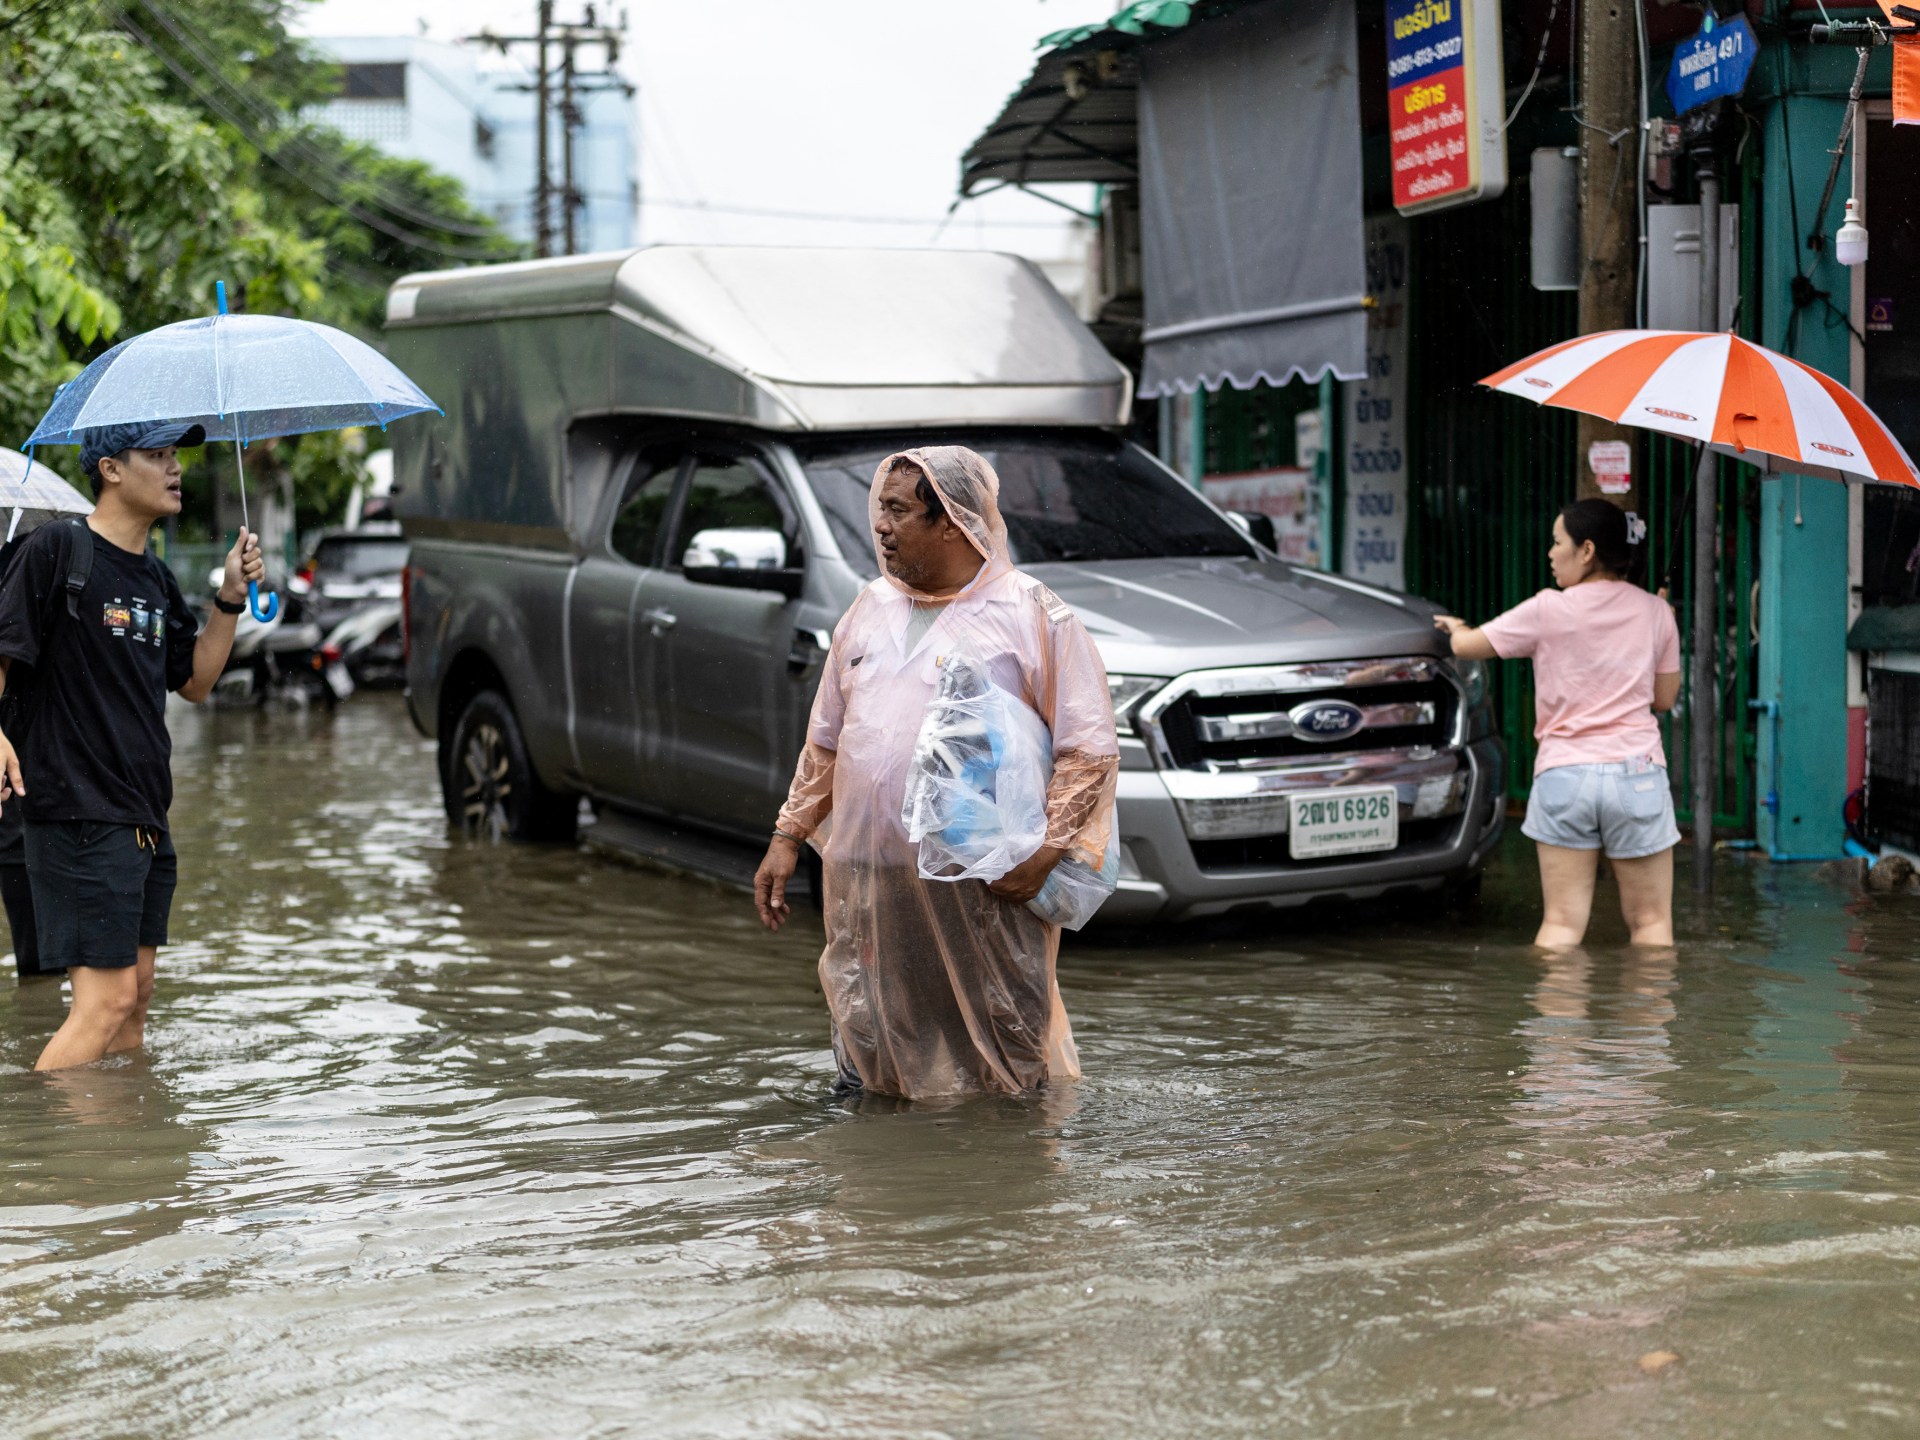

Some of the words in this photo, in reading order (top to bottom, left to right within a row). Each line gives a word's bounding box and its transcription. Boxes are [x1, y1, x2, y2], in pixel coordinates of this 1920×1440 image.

[1394, 0, 1450, 39] แอร์บ้าน
[1719, 31, 1742, 60] 49/1
[1714, 65, 1719, 84] 1
[1404, 84, 1447, 114] บริการ
[1312, 709, 1350, 730] Ford
[1344, 796, 1389, 822] 6926
